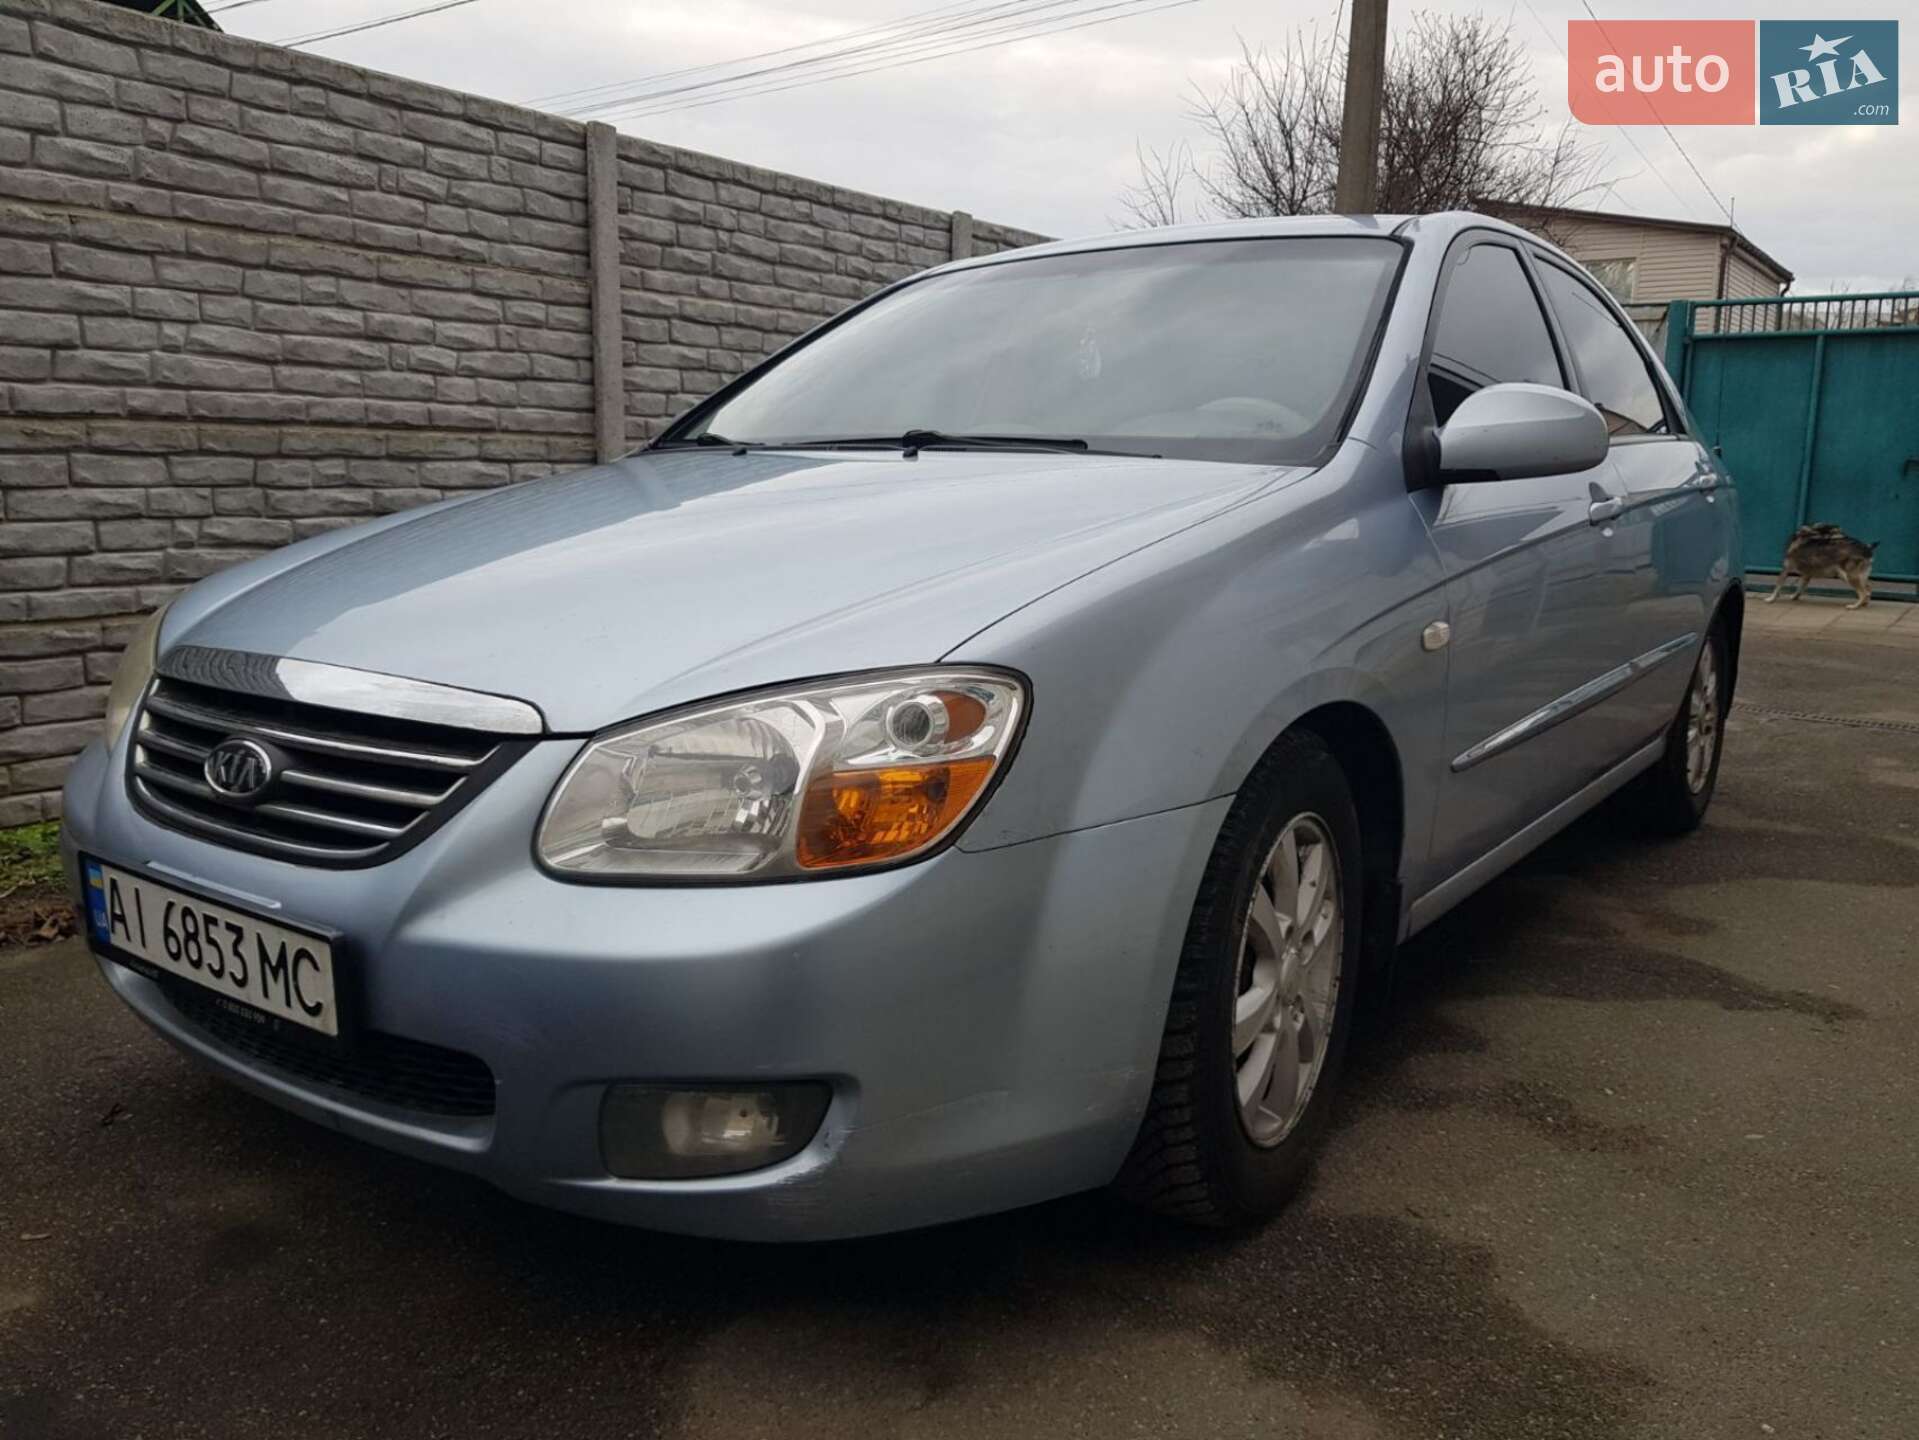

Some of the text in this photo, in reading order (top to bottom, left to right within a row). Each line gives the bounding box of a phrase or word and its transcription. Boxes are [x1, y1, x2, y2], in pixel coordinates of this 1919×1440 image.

[210, 750, 256, 789] KIA
[109, 876, 324, 1017] AI 6853 MC
